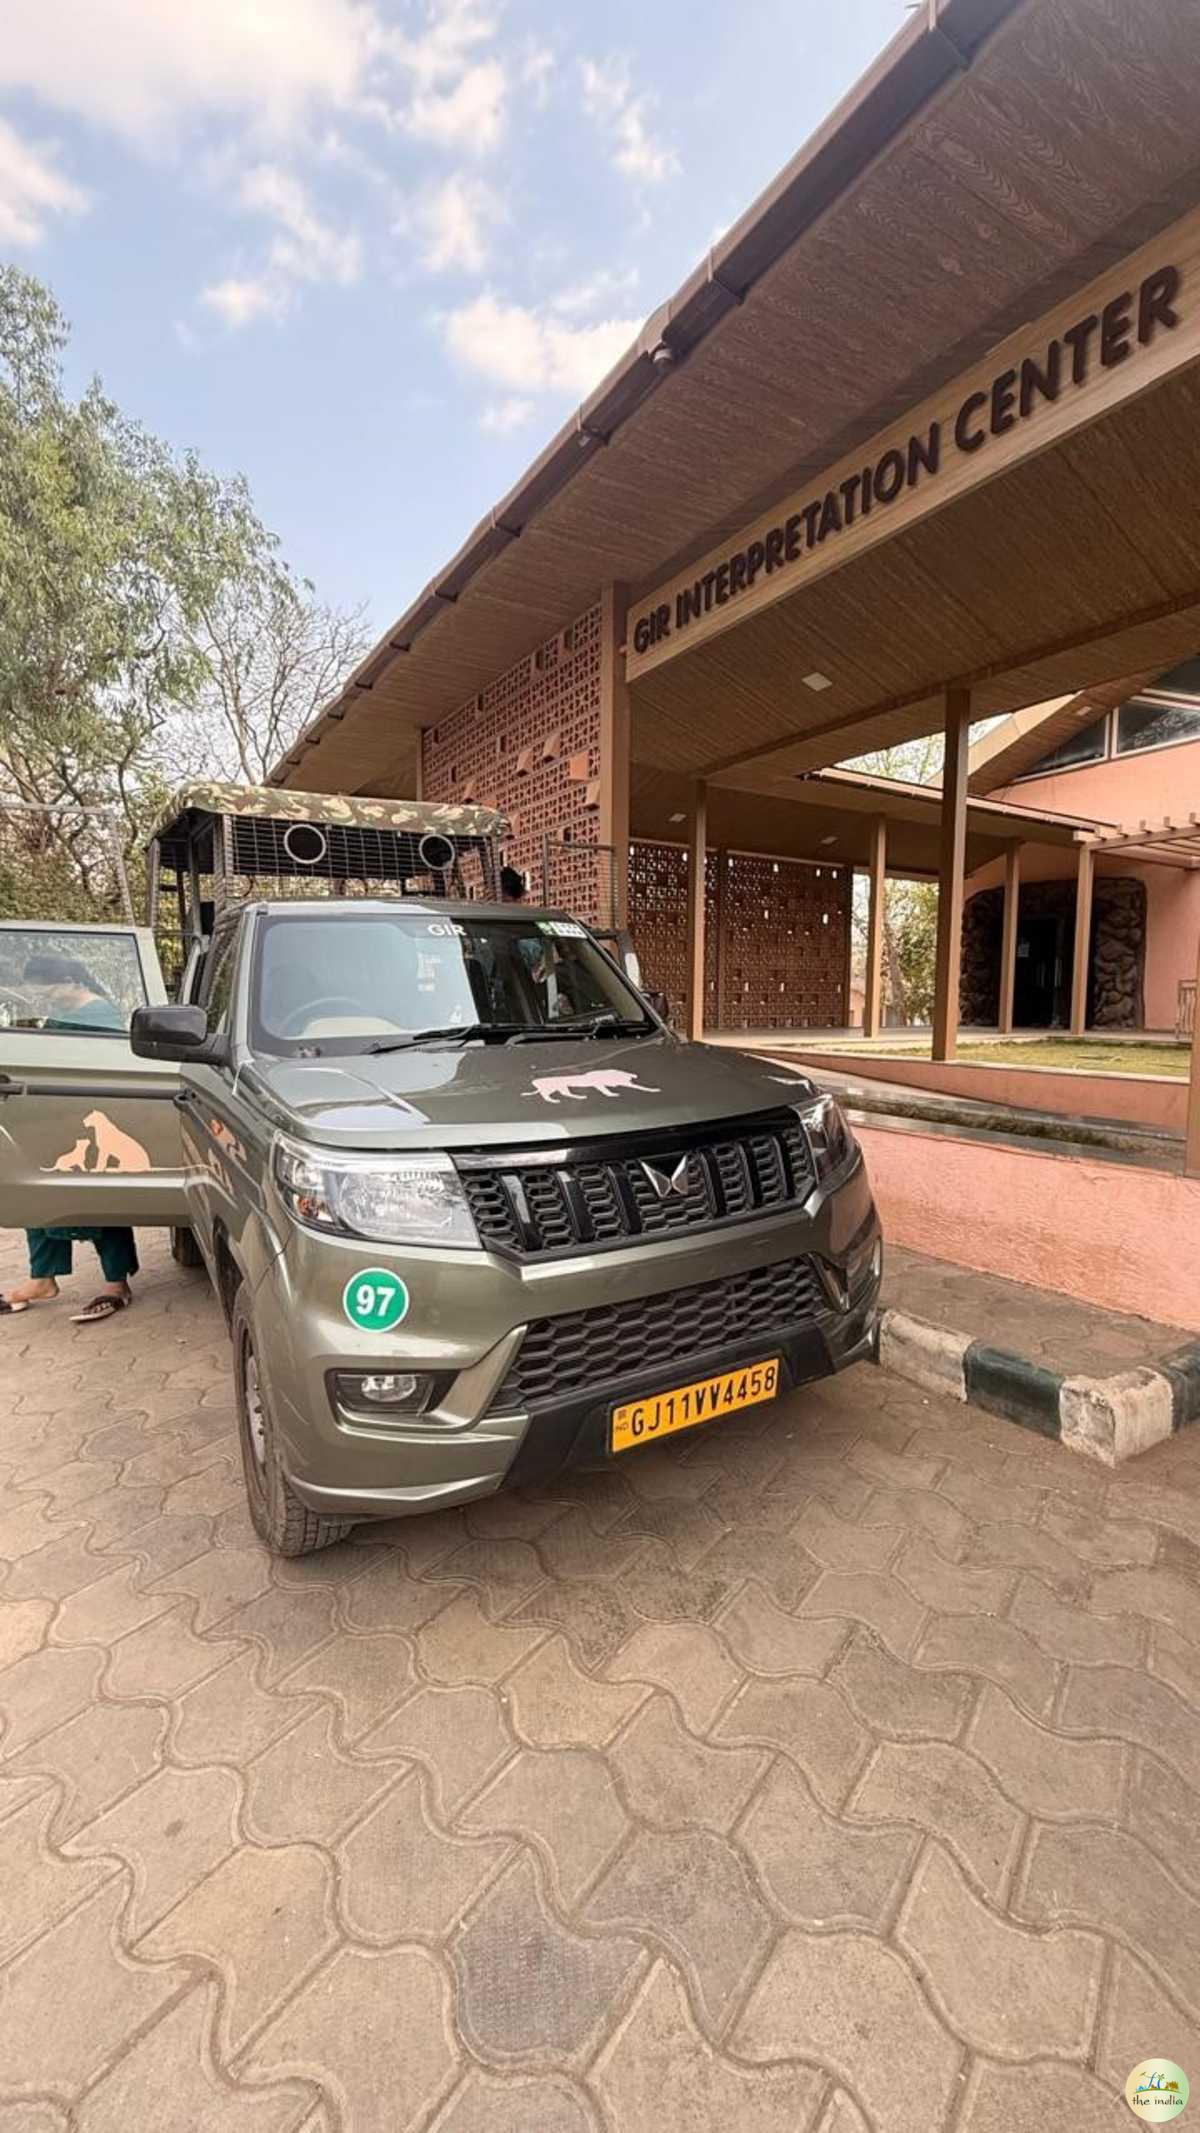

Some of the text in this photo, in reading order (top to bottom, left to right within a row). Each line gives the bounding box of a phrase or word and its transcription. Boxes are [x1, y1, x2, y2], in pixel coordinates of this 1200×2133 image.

[634, 265, 1183, 654] GIR INTERPRETATION CENTER
[427, 923, 467, 936] GIR
[356, 1285, 396, 1316] 97
[631, 1366, 776, 1436] GJ11VV4458
